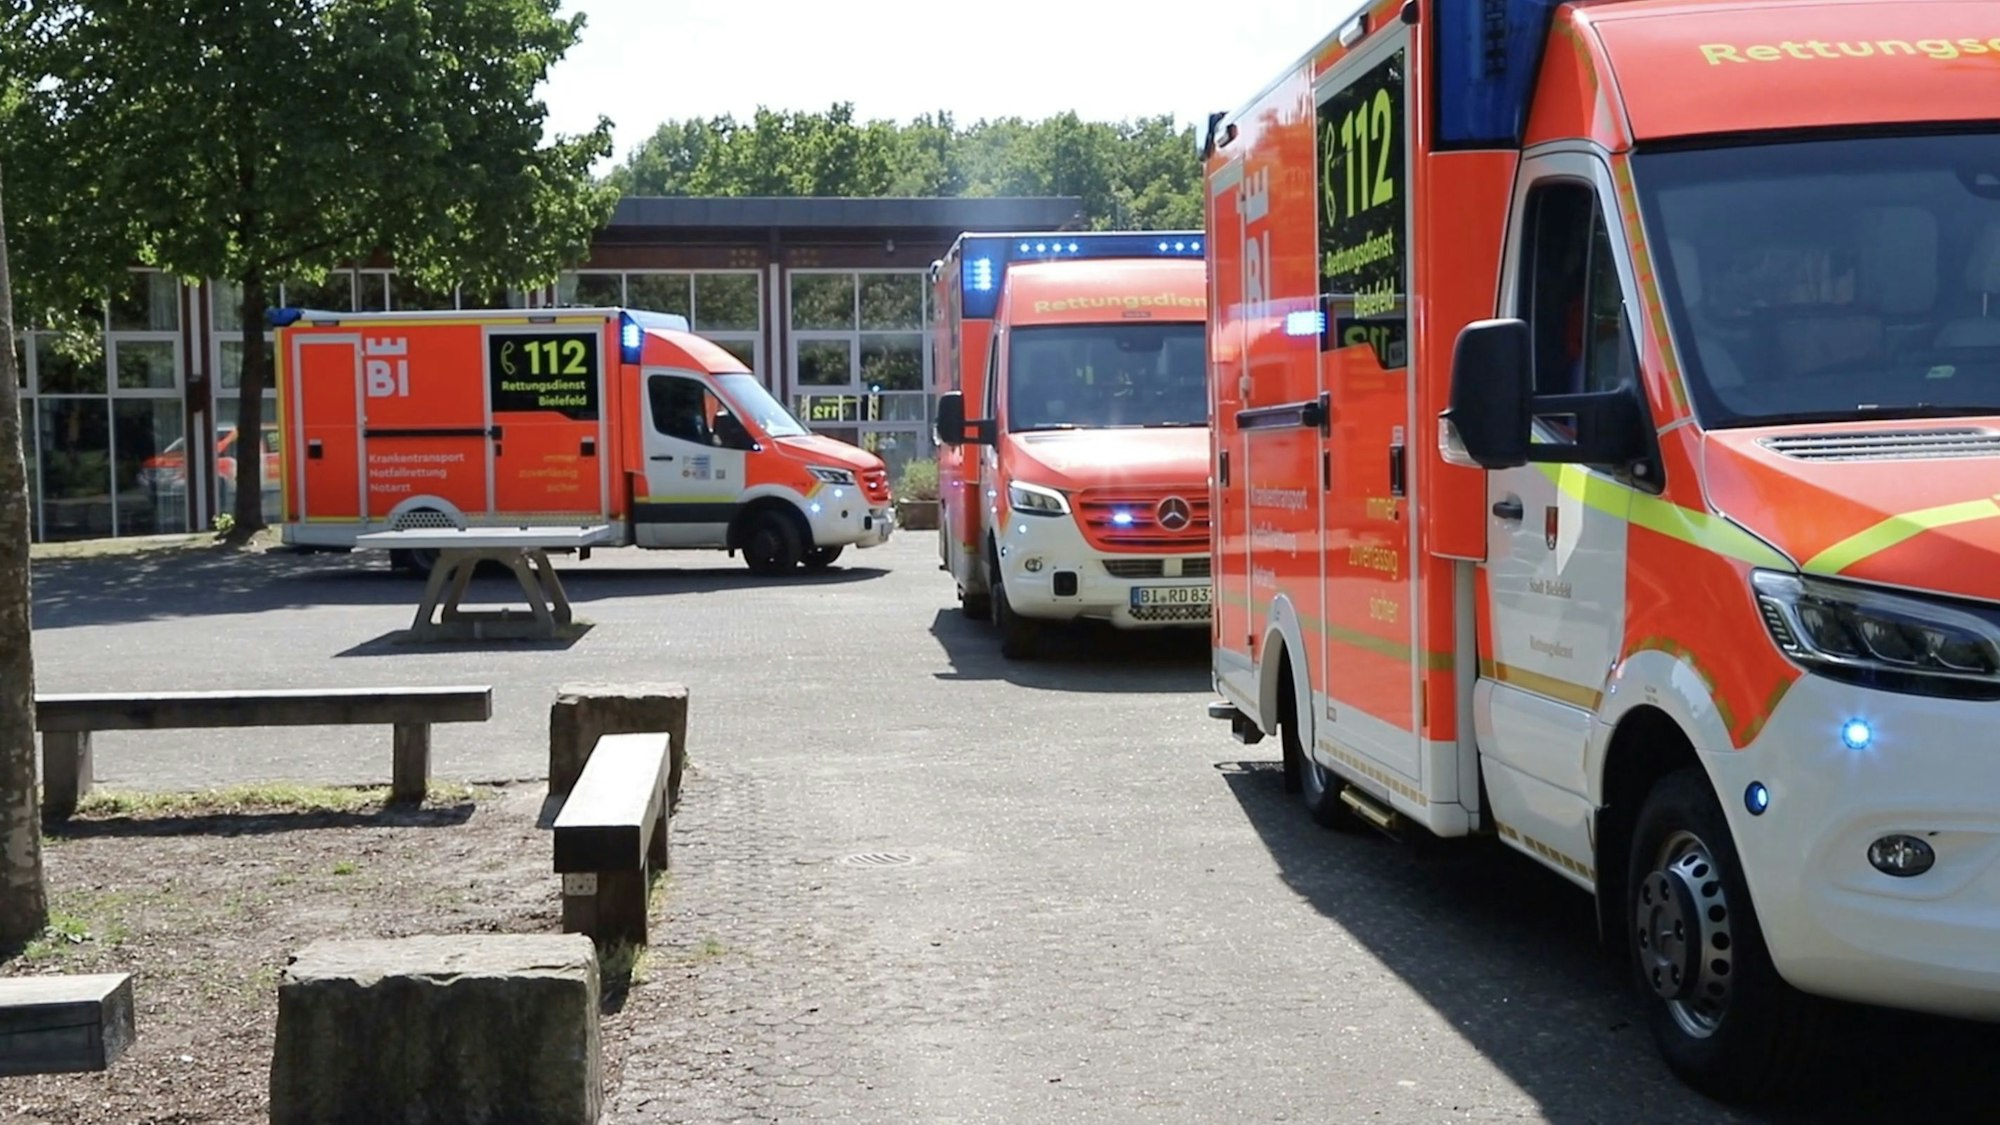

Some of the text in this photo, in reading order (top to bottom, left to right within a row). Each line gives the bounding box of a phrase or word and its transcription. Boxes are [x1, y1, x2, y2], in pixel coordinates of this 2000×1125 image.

[1341, 88, 1393, 218] 112
[1326, 226, 1394, 278] Rettungsdienst
[1354, 276, 1395, 319] Bielefeld
[524, 339, 588, 375] 112
[366, 360, 409, 397] BI
[501, 379, 586, 393] Rettungsdienst
[538, 395, 587, 406] Bielefeld
[368, 453, 465, 466] Krankentransport
[369, 468, 447, 479] Notfallrettung
[370, 484, 411, 493] Notarzt
[1141, 590, 1158, 603] BI
[1191, 588, 1212, 602] 83
